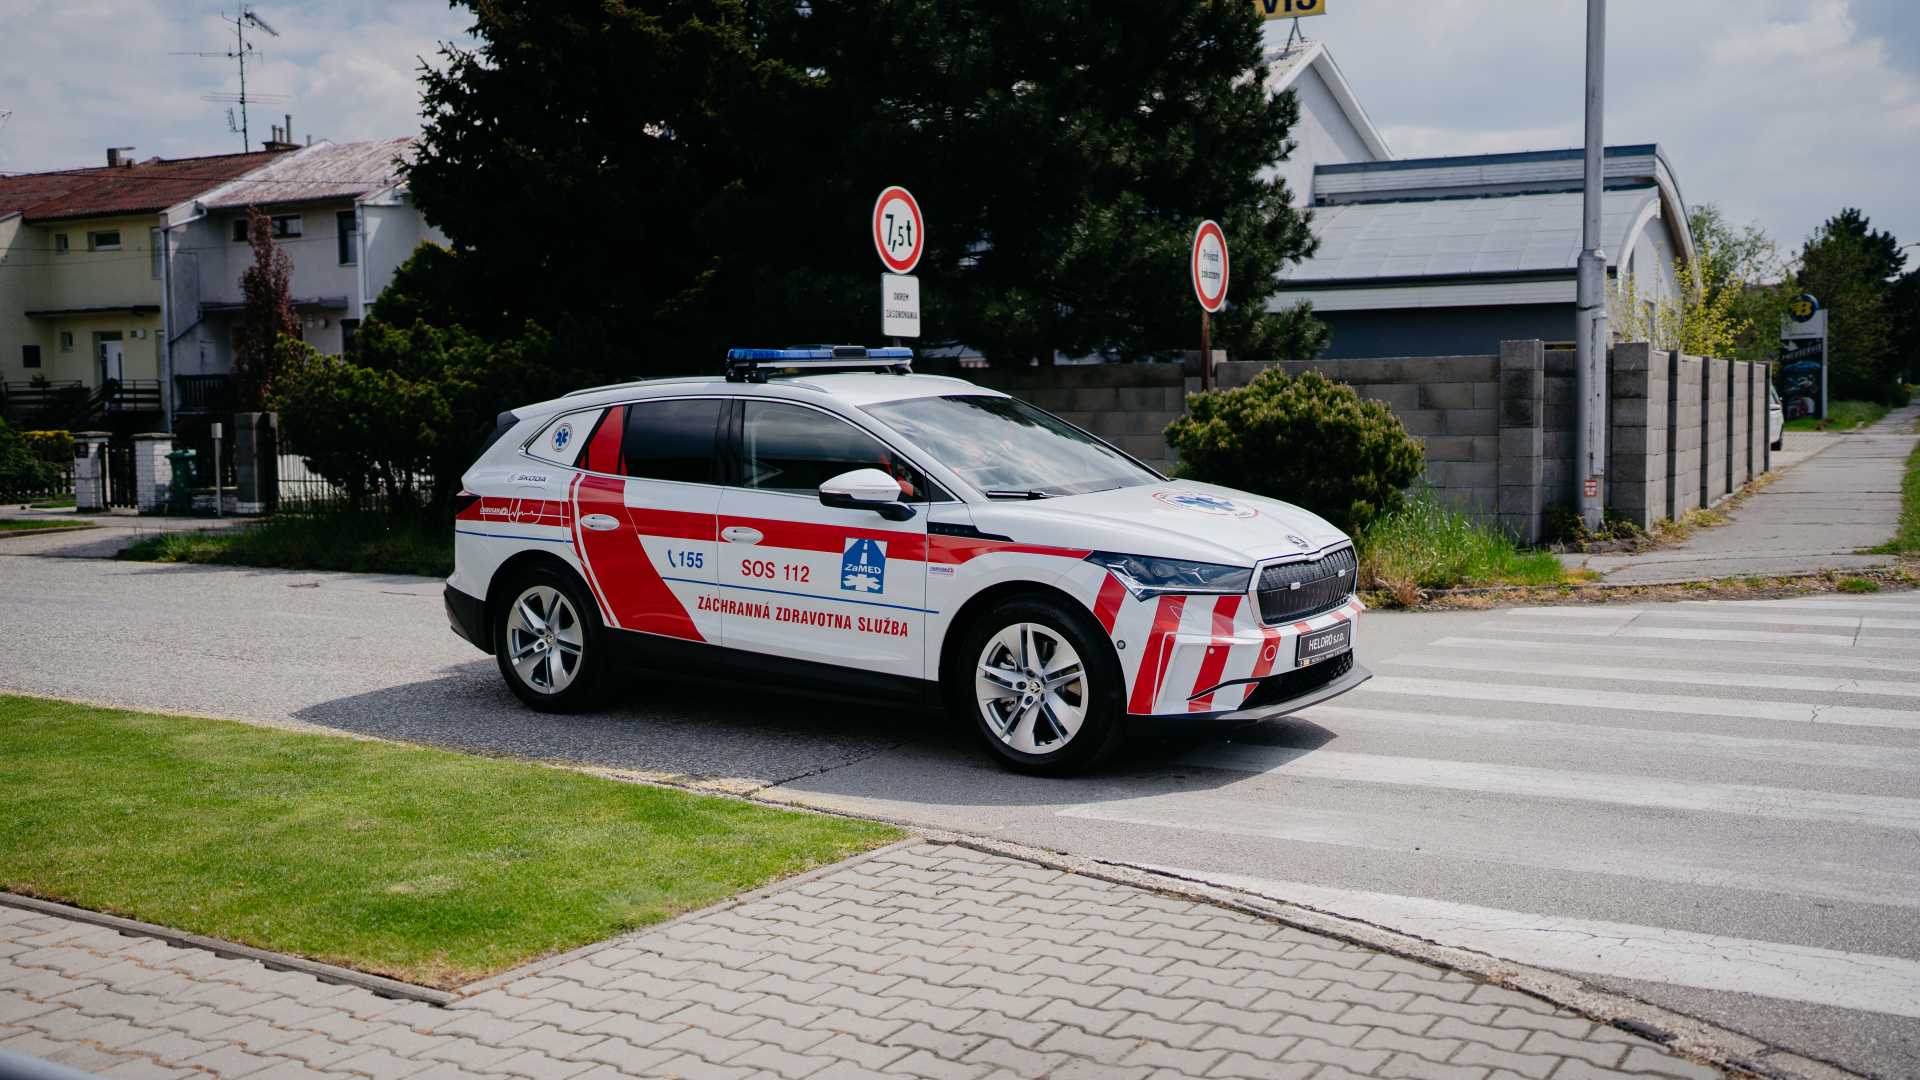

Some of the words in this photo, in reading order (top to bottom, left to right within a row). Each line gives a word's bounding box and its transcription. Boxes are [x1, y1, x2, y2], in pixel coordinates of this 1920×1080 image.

[678, 551, 703, 568] 155
[845, 563, 881, 574] ZaMED
[741, 559, 775, 579] SOS
[783, 564, 809, 583] 112
[698, 594, 770, 619] ZÁCHRANNÁ
[775, 606, 852, 629] ZDRAVOTNA
[857, 616, 908, 637] SLUŽBA
